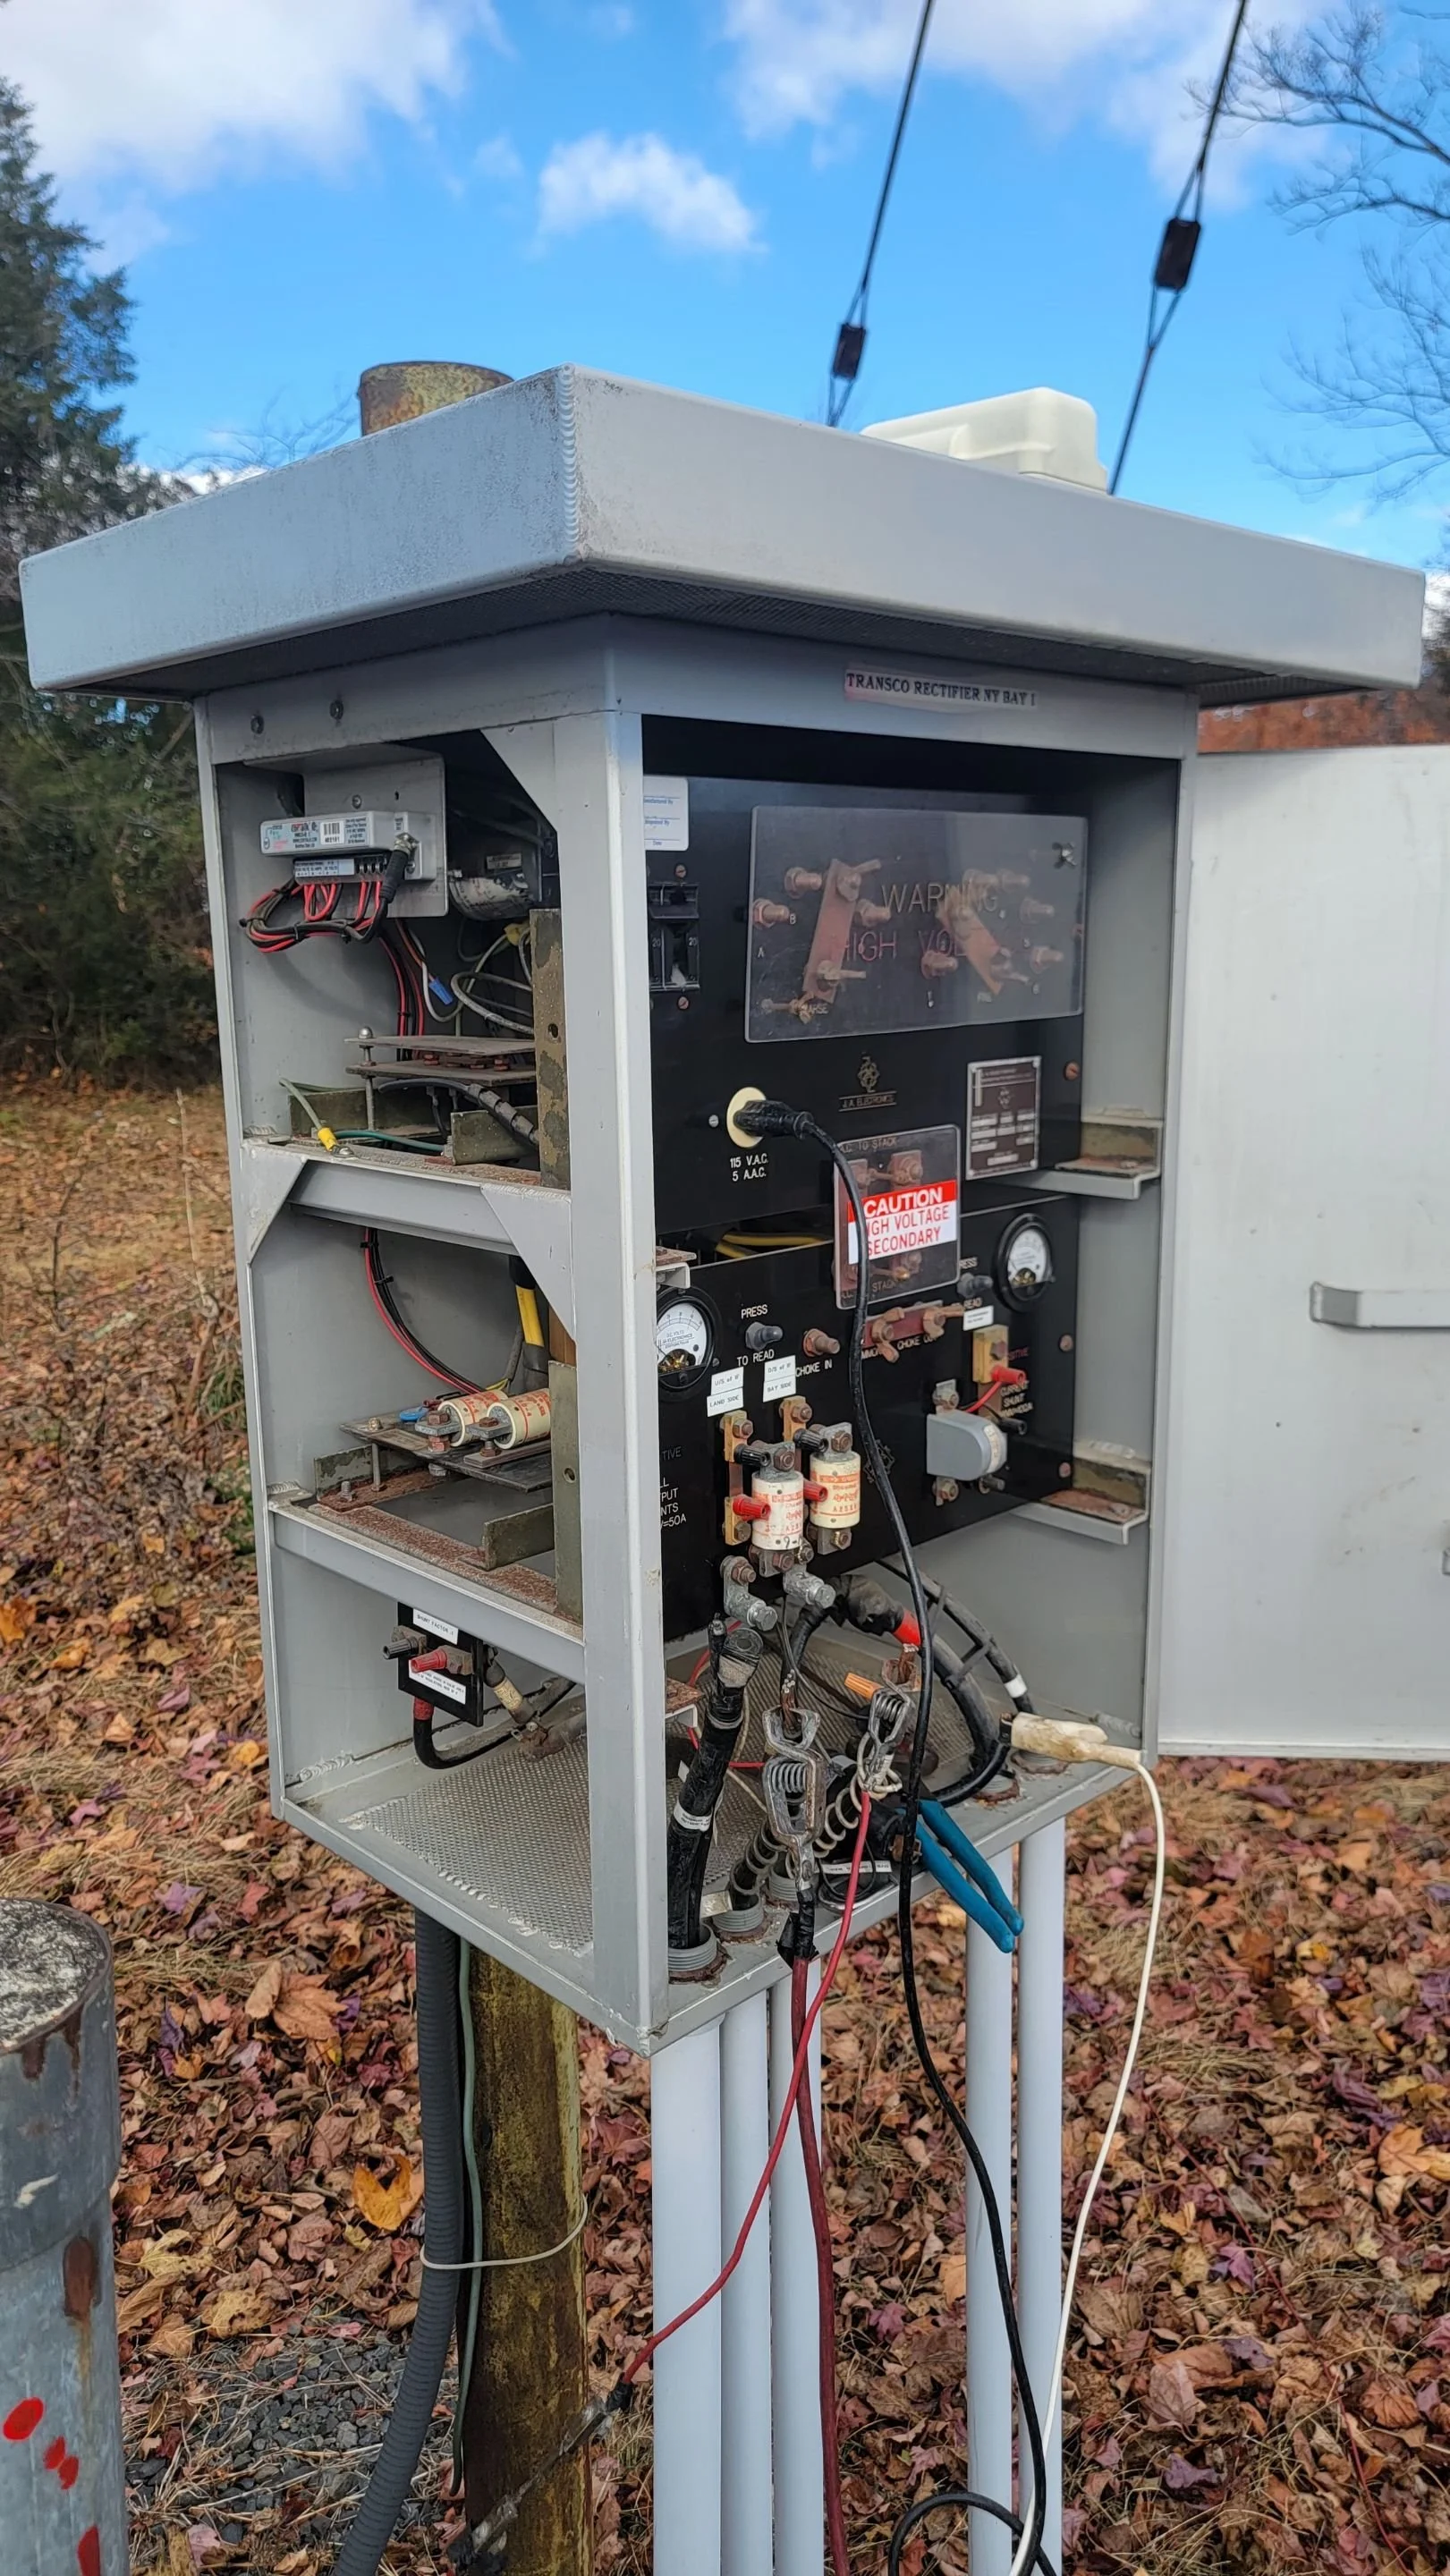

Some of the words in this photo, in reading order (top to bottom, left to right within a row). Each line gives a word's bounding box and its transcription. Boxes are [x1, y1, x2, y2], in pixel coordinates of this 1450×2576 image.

[846, 673, 910, 693] TRANSCO
[913, 681, 980, 701] RECTIFIER
[730, 1156, 742, 1168] 115
[732, 1169, 739, 1182] 5
[863, 1186, 943, 1218] CAUTION
[866, 1217, 889, 1236] IGH
[895, 1205, 950, 1231] VOLTAGE
[868, 1226, 941, 1256] SECONDARY
[741, 1304, 768, 1319] PRESS
[897, 1336, 920, 1351] CHOKE
[736, 1356, 749, 1368] TO
[753, 1349, 775, 1363] READ
[795, 1362, 820, 1377] CHOKE
[825, 1359, 833, 1370] IN
[710, 1398, 725, 1407] LAND
[727, 1394, 740, 1403] SIDE
[662, 1446, 683, 1462] TIVE
[661, 1487, 679, 1503] PUT
[660, 1503, 679, 1516] NTS
